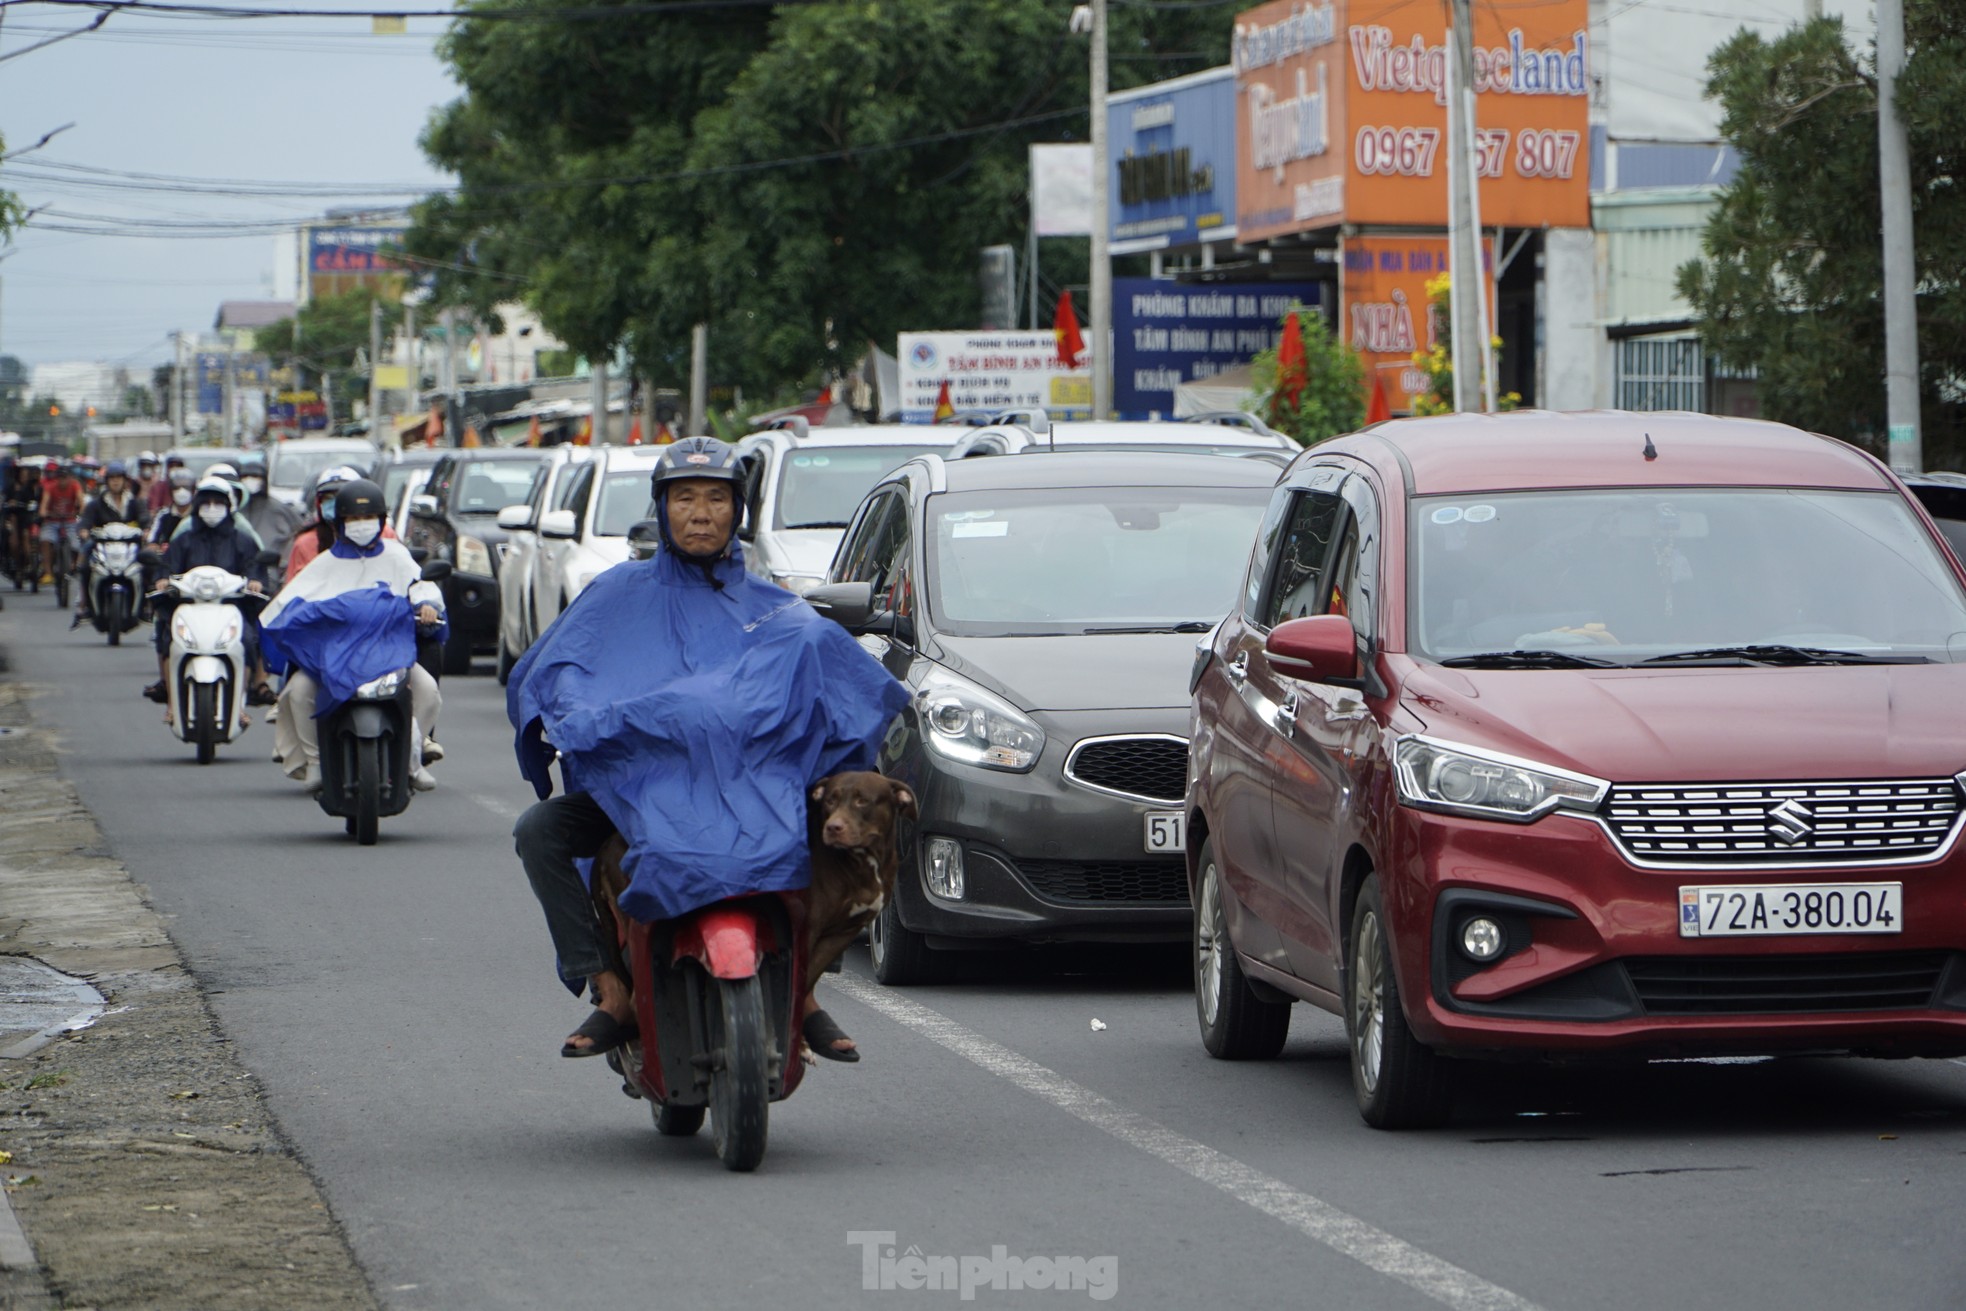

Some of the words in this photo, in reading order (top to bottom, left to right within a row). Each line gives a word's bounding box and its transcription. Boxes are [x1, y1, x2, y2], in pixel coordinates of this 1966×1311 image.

[1350, 25, 1588, 105] Vietqocland
[1356, 125, 1440, 177] 0967
[1516, 128, 1580, 179] 807
[1152, 818, 1179, 847] 51
[1706, 889, 1894, 931] 72A-380.04
